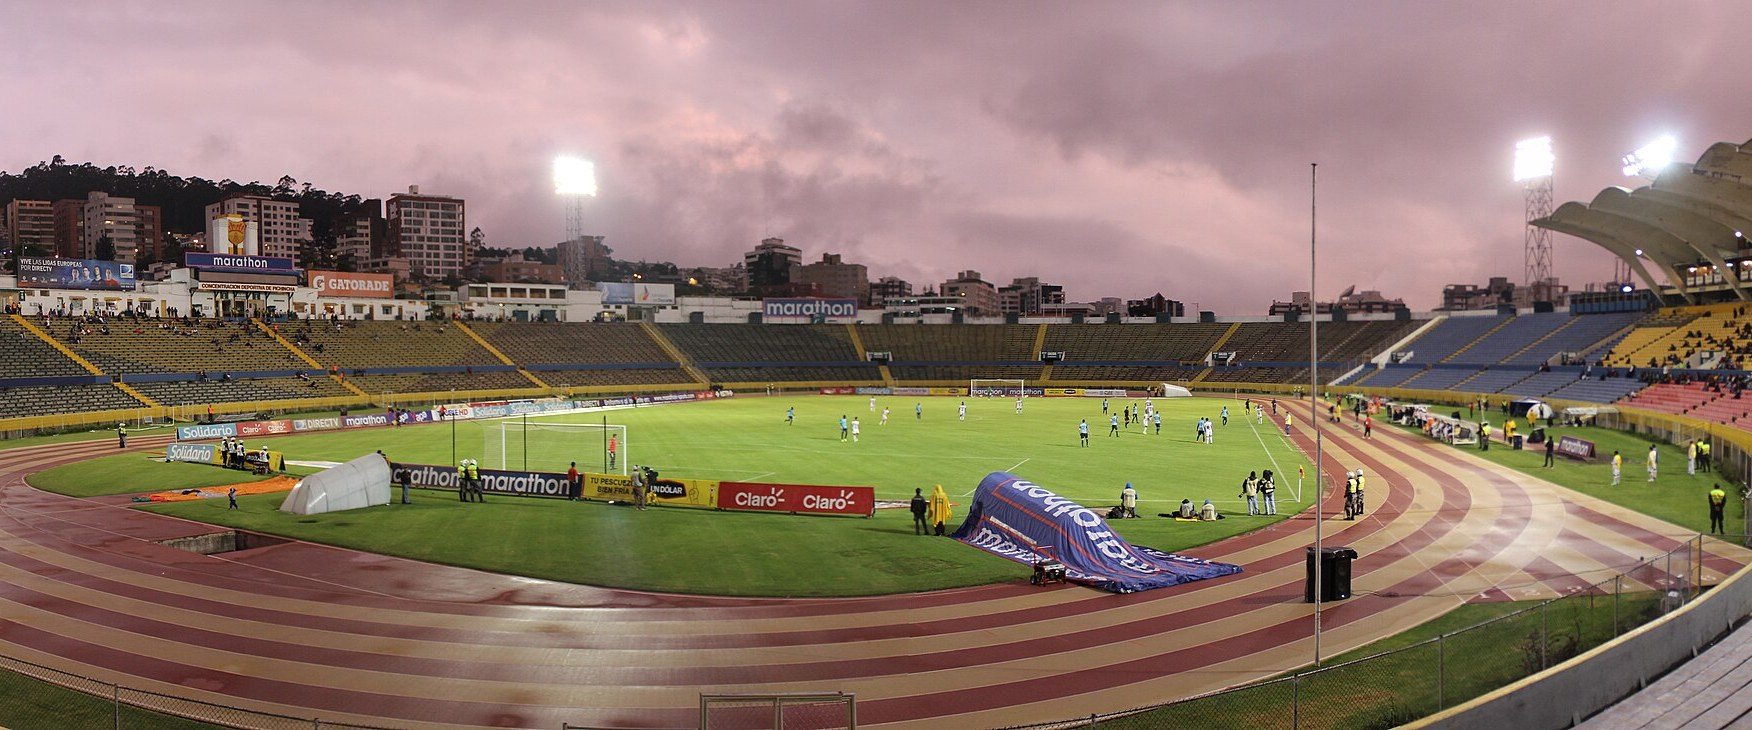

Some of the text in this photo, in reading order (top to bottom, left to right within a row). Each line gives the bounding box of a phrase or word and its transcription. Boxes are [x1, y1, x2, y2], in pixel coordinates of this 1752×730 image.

[213, 256, 268, 268] marathon
[312, 275, 389, 292] G GATORADE
[767, 300, 854, 316] marathon
[475, 406, 507, 417] Solidario
[512, 402, 540, 413] Solidario
[307, 418, 339, 429] DIRECTV
[346, 415, 387, 427] marathon
[183, 425, 233, 439] Solidario
[243, 425, 260, 433] Claro
[169, 445, 211, 461] Solidario
[1561, 439, 1589, 457] marathon
[480, 473, 570, 495] marathon
[600, 478, 634, 487] PESCUEZ
[597, 485, 613, 494] BIEN
[650, 484, 683, 495] UN DÓLAR
[735, 489, 780, 508] Claro
[803, 491, 849, 510] Claro
